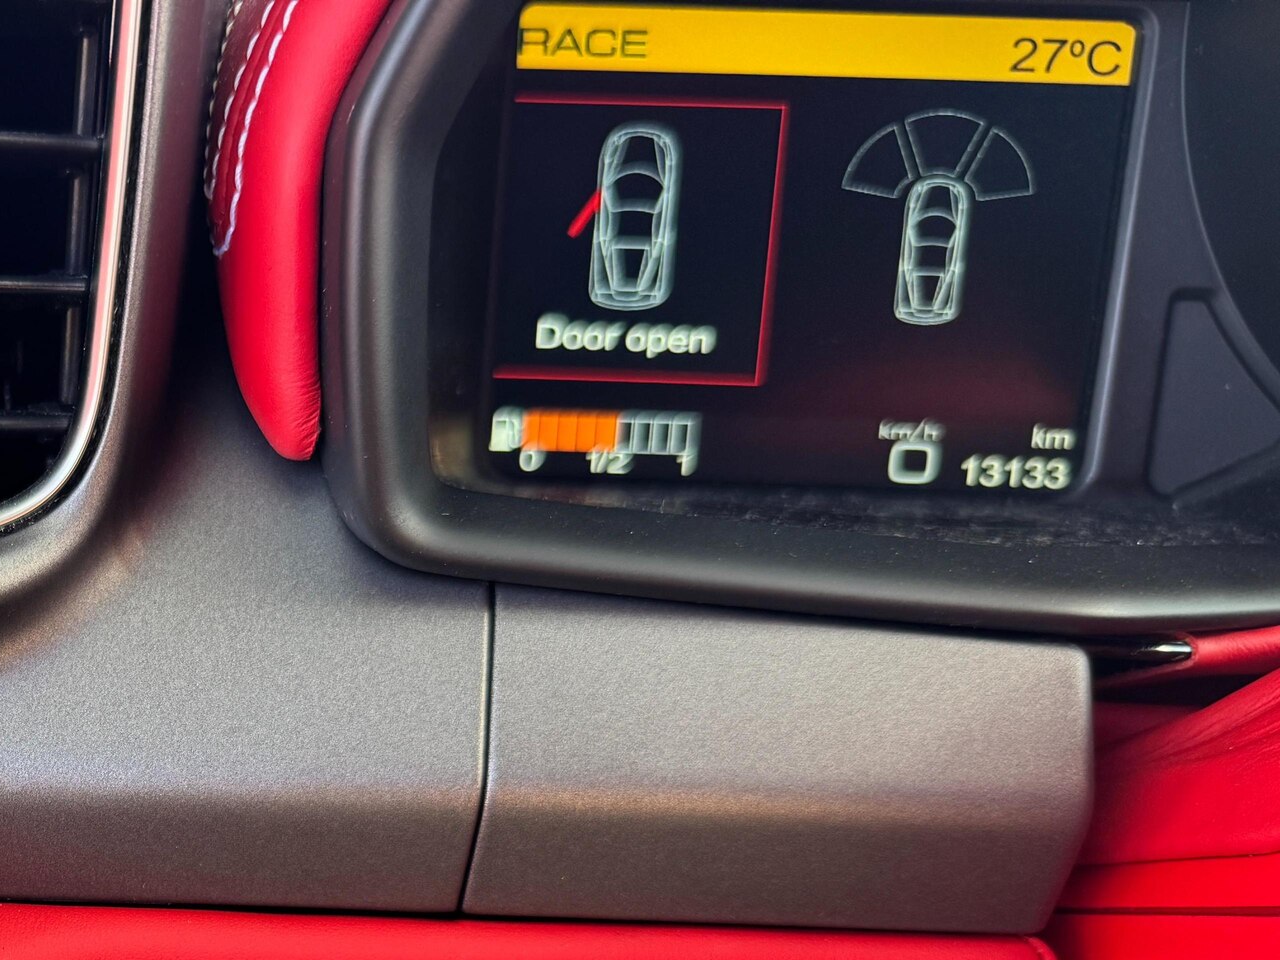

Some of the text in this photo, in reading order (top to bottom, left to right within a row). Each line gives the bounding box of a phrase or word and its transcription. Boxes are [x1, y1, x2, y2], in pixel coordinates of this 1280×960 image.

[518, 27, 648, 59] RACE
[535, 315, 717, 359] Door open
[1031, 423, 1075, 450] km
[960, 454, 1070, 490] 13133
